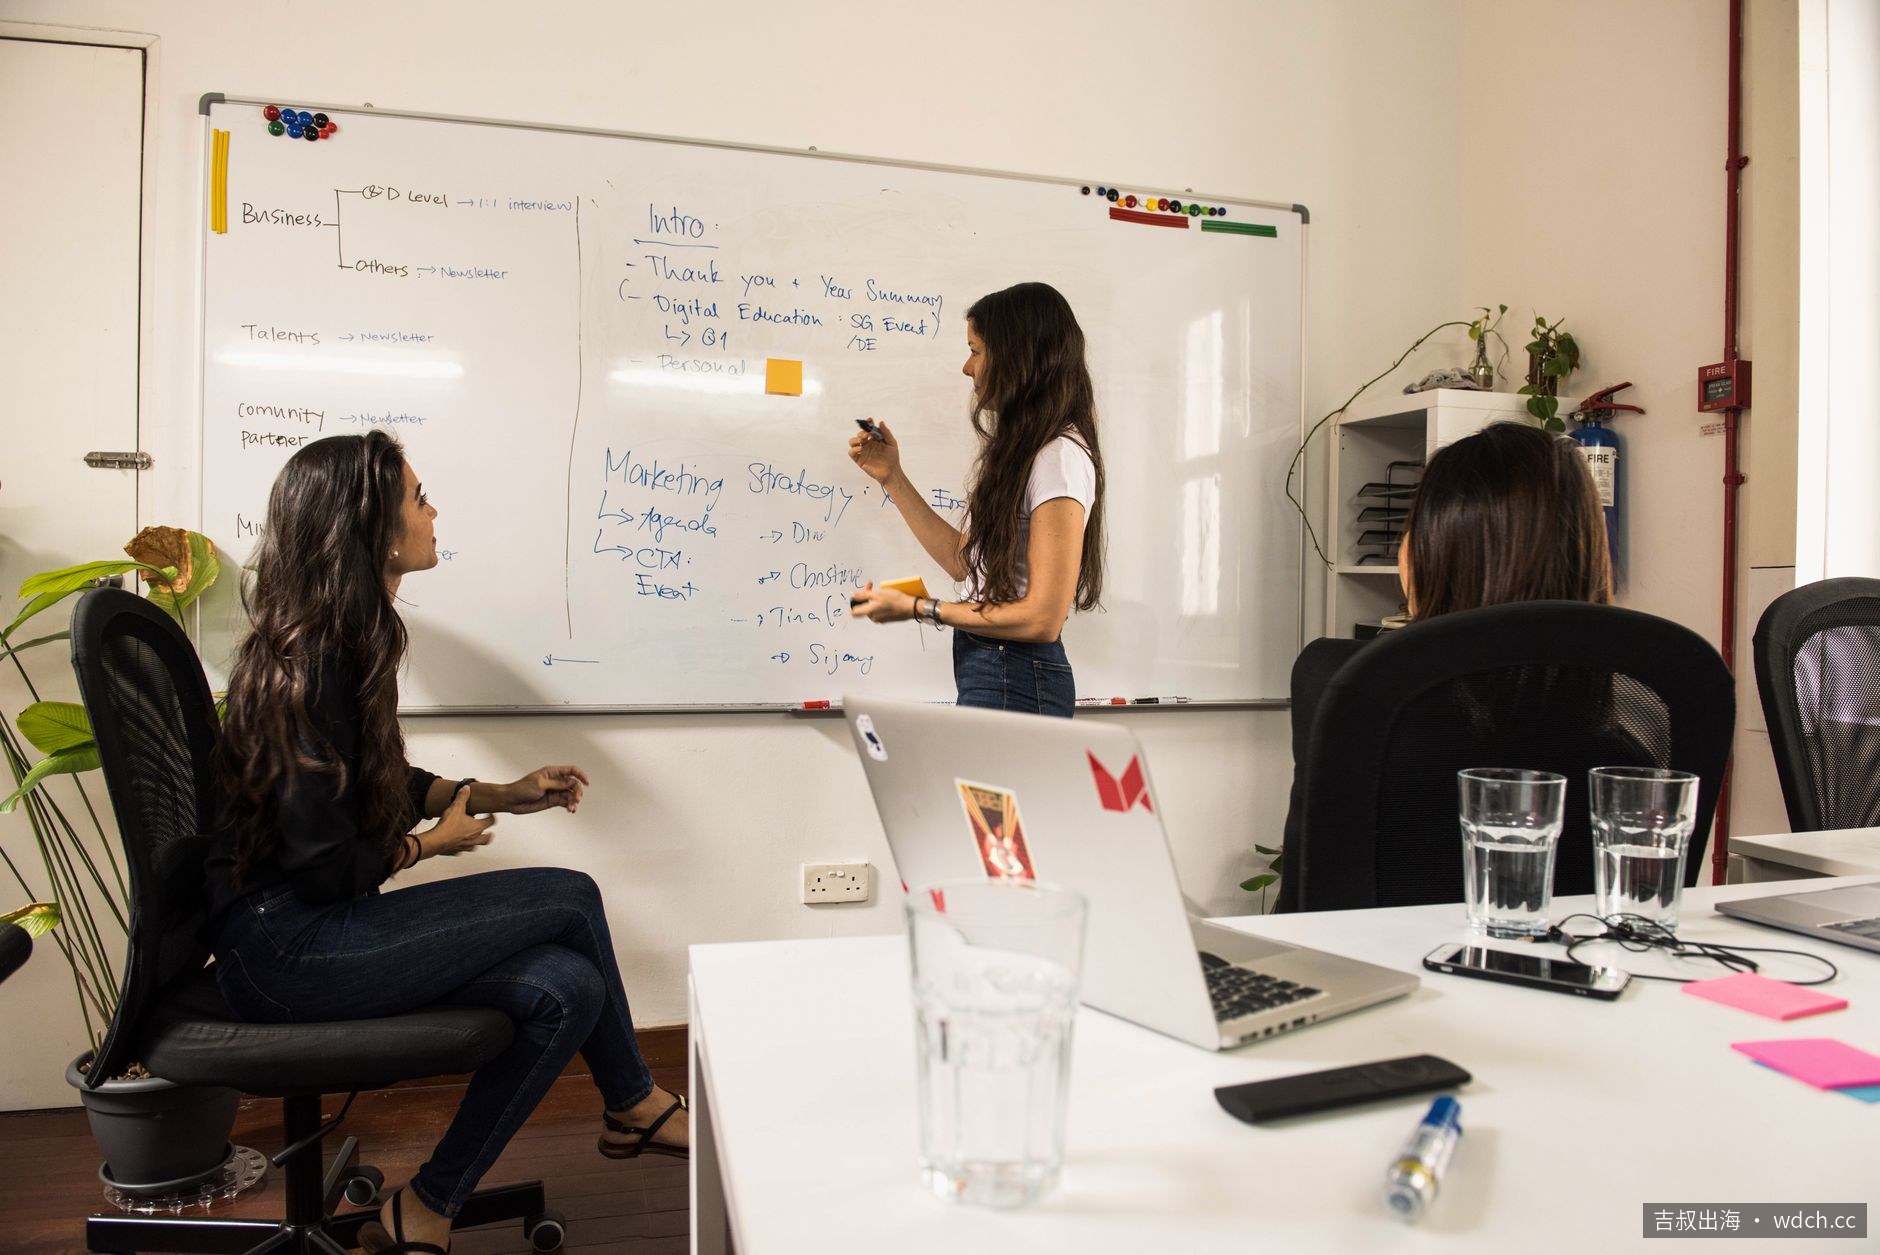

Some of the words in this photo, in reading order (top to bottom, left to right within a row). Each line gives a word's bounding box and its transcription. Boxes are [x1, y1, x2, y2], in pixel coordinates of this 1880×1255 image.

[409, 191, 448, 208] Level
[508, 198, 573, 211] interview
[243, 203, 322, 227] Business
[355, 259, 408, 277] Others
[440, 265, 509, 280] Newsletter
[645, 255, 724, 283] Thank
[741, 275, 775, 297] you
[820, 275, 852, 300] Year
[866, 279, 944, 313] Summary
[653, 294, 720, 325] Digital
[738, 303, 823, 327] Education
[850, 314, 874, 331] SG
[241, 323, 321, 345] Talents
[360, 331, 435, 343] Newsletter
[657, 354, 747, 377] Personal
[1706, 366, 1726, 377] FIRE
[1587, 454, 1610, 464] FIRE
[605, 447, 724, 511] Marketing
[641, 506, 718, 543] Agenda
[635, 573, 700, 601] Event
